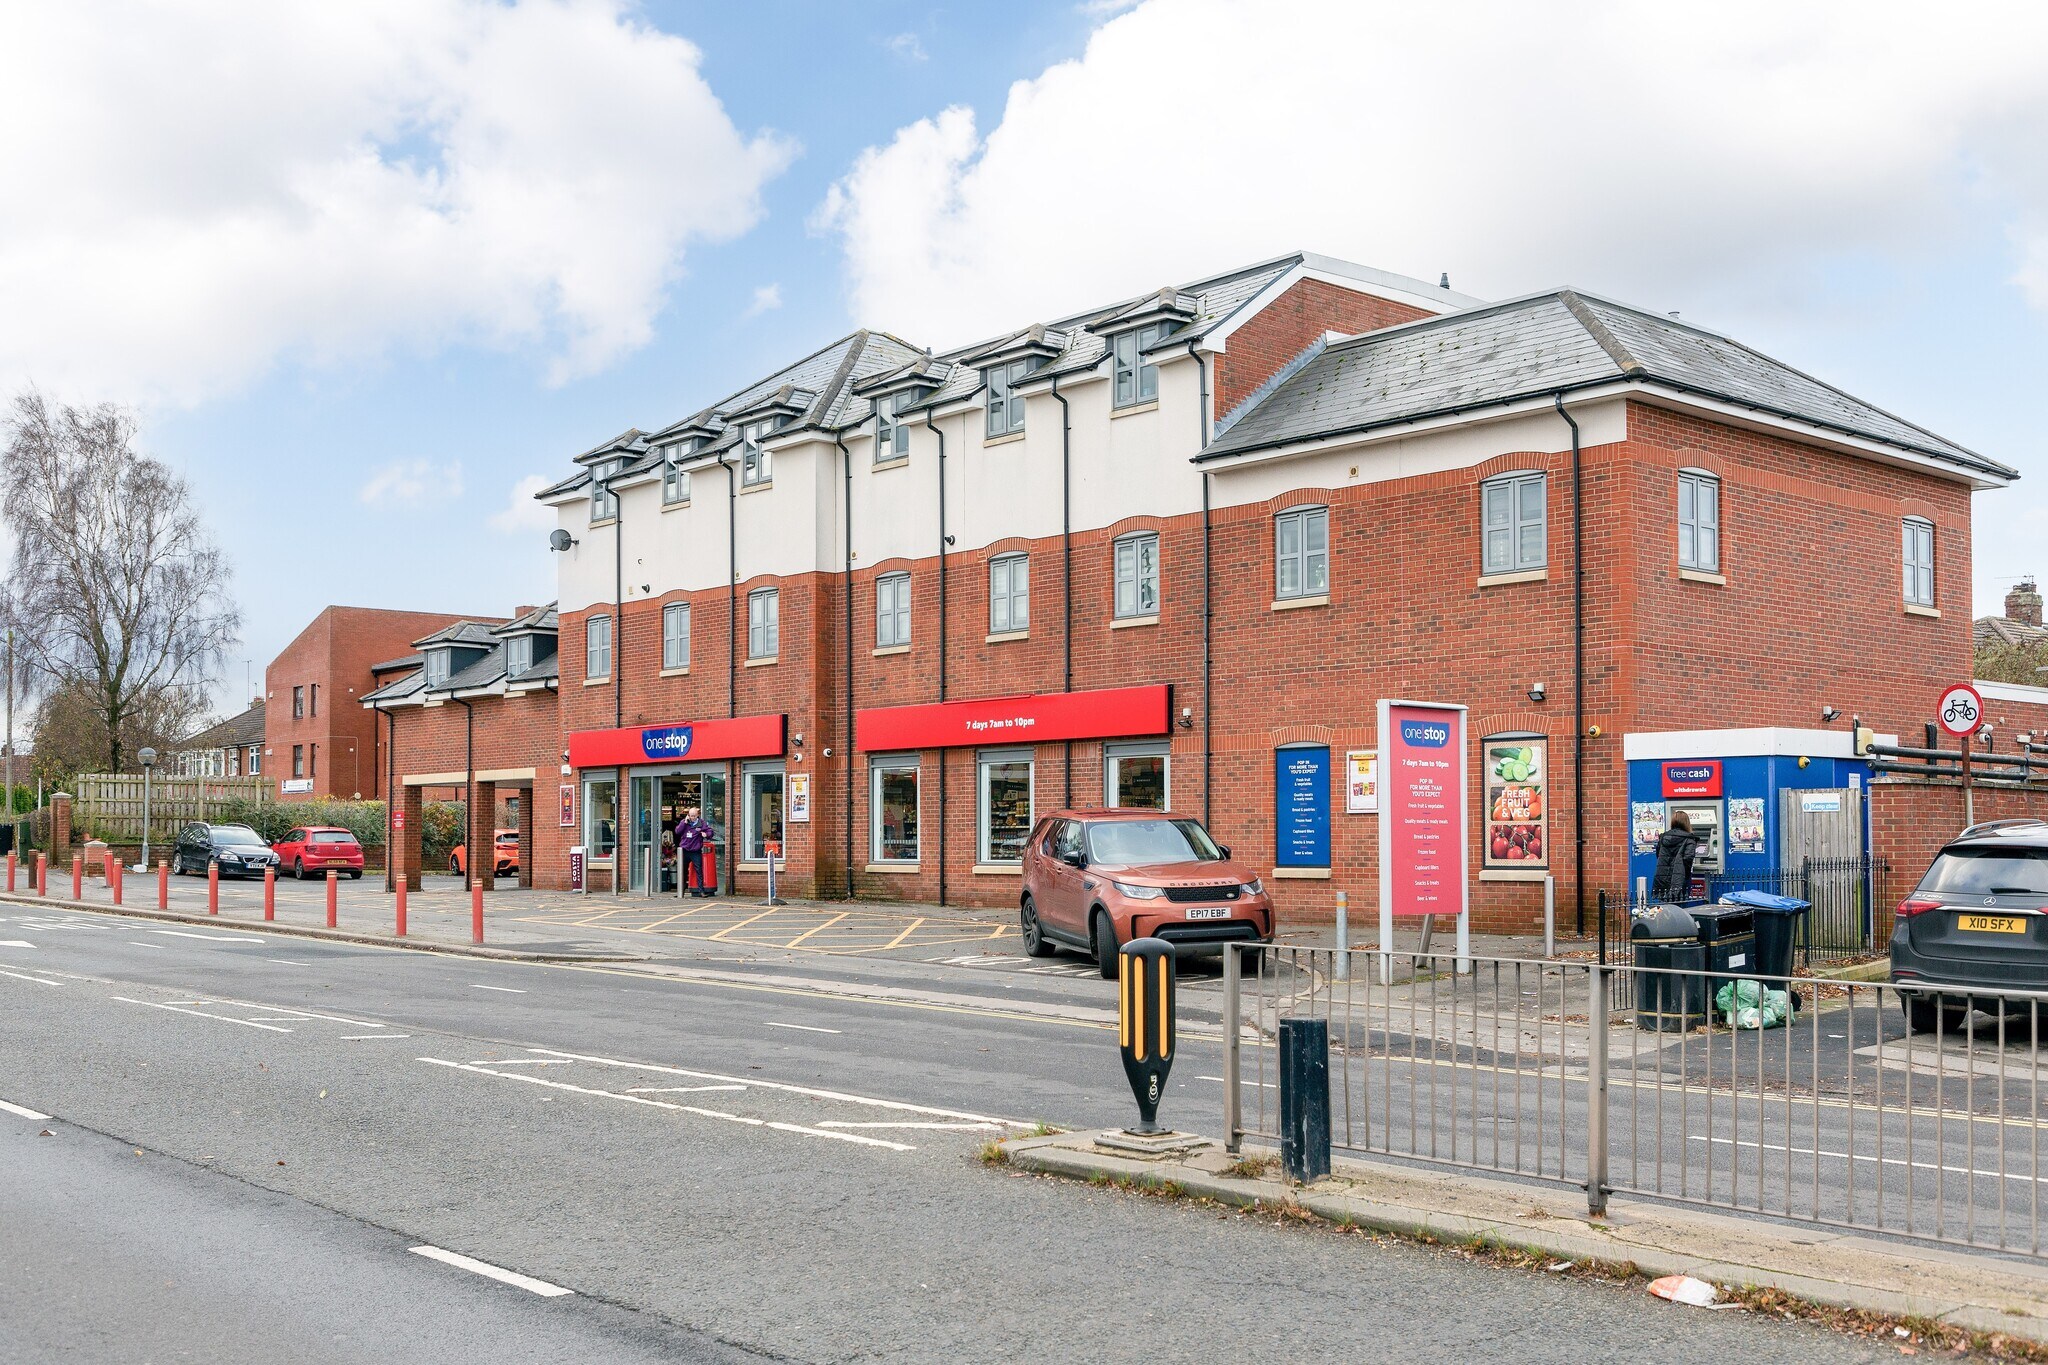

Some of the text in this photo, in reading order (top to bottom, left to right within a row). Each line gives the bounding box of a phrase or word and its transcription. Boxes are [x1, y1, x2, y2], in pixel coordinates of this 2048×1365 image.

[966, 717, 1035, 731] 7 days 7am to 10pm
[1404, 726, 1445, 745] one stop
[646, 732, 688, 753] one stop
[1406, 759, 1418, 768] days
[1435, 760, 1449, 769] 10pm
[1671, 768, 1709, 778] free cash
[1501, 790, 1530, 798] FRESH
[1501, 798, 1530, 808] FRUIT
[1812, 802, 1825, 810] Keep
[1502, 808, 1530, 818] & VEG
[1190, 908, 1226, 918] EP17 EBF
[1969, 917, 2014, 931] X10 SFX
